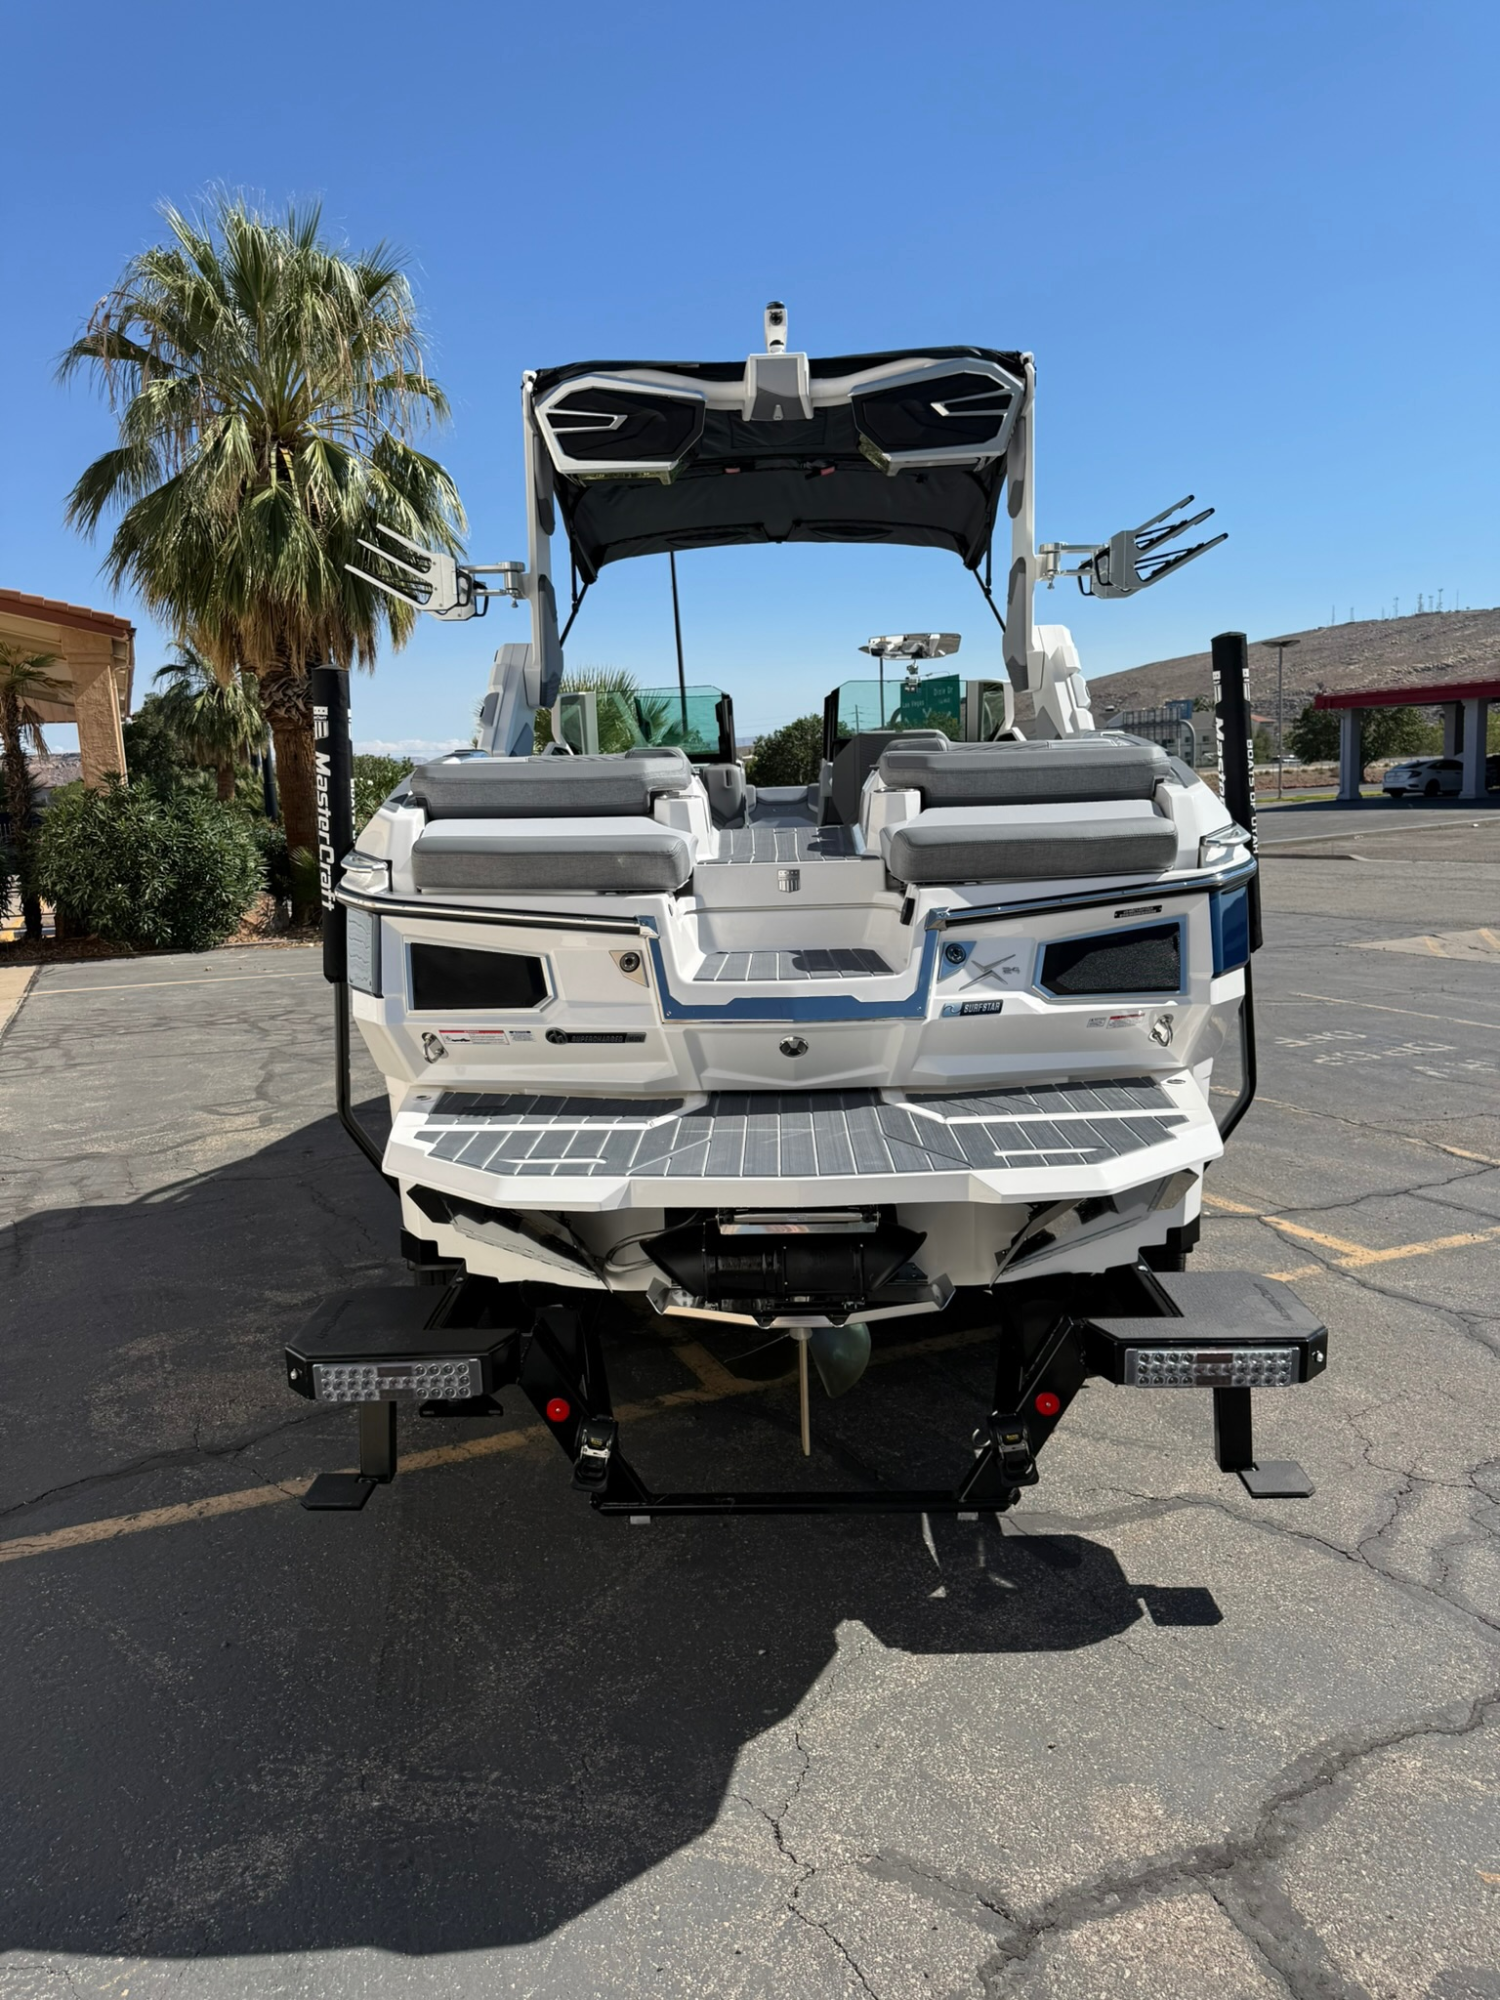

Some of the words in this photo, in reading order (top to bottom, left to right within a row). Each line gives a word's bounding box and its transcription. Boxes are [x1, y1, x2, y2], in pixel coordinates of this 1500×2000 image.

[1246, 739, 1255, 787] BOATS
[1250, 792, 1257, 811] OF
[315, 751, 336, 911] MasterCraft
[1251, 816, 1259, 854] UTAH
[963, 1002, 1001, 1014] SURFSTAR
